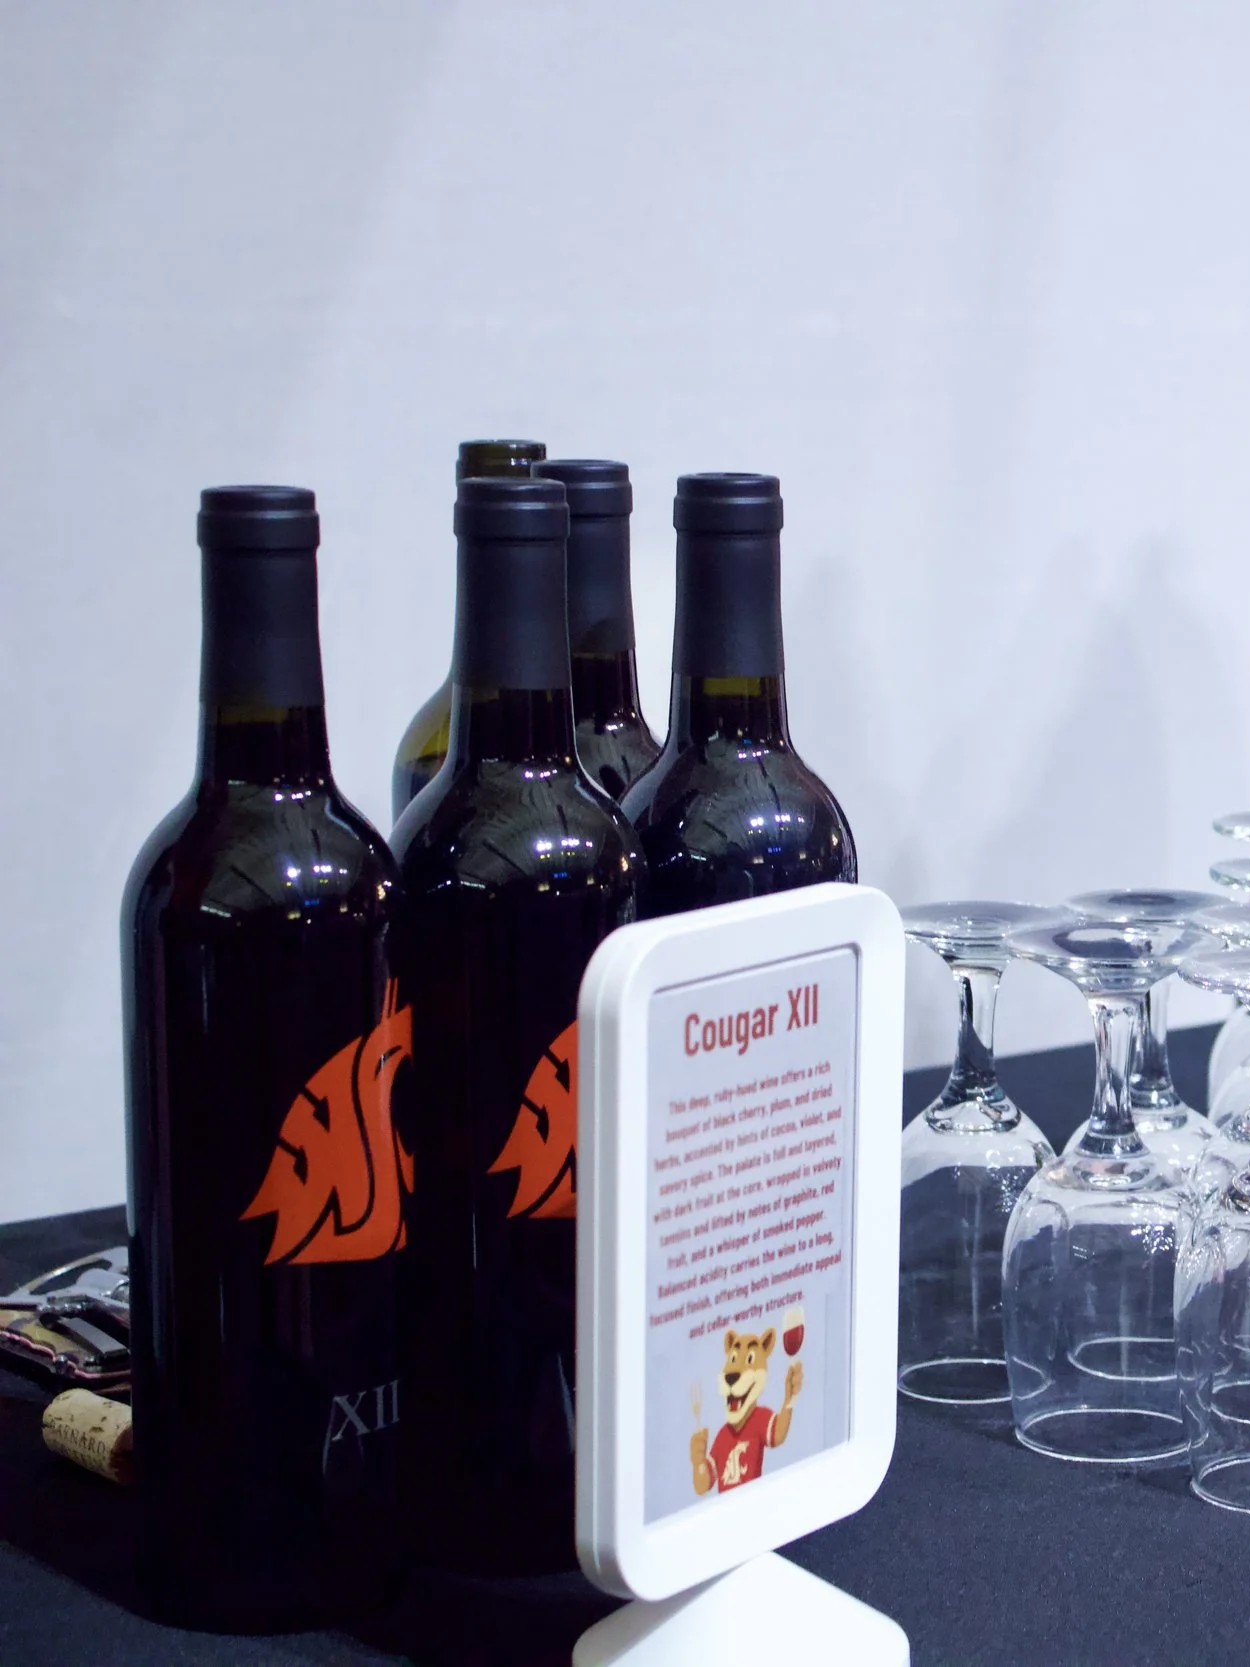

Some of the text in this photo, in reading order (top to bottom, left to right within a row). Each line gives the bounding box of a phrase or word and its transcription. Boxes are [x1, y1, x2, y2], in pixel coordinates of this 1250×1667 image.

[684, 983, 820, 1056] Cougar XII
[670, 1102, 686, 1114] This
[714, 1080, 757, 1102] ruby-hued
[760, 1077, 778, 1090] wine
[781, 1070, 805, 1085] offers
[808, 1068, 812, 1078] a
[815, 1062, 830, 1076] rich
[703, 1118, 711, 1132] of
[714, 1112, 736, 1128] black
[795, 1091, 809, 1106] and
[812, 1085, 832, 1101] dried
[725, 1139, 734, 1152] by
[760, 1126, 768, 1140] of
[827, 1106, 841, 1121] and
[718, 1164, 733, 1177] The
[736, 1156, 761, 1175] palate
[764, 1153, 770, 1164] is
[773, 1146, 786, 1161] full
[789, 1141, 802, 1156] and
[654, 1208, 673, 1224] with
[674, 1201, 692, 1217] dark
[696, 1194, 713, 1210] fruit
[716, 1191, 724, 1204] at
[728, 1187, 740, 1200] the
[767, 1166, 801, 1188] wrapped
[803, 1164, 810, 1177] in
[814, 1157, 841, 1174] velvety
[694, 1220, 709, 1236] and
[736, 1210, 745, 1224] by
[748, 1203, 771, 1218] notes
[774, 1196, 781, 1211] of
[822, 1180, 834, 1195] red
[691, 1246, 706, 1263] and
[710, 1246, 714, 1257] a
[717, 1235, 750, 1254] whisper
[752, 1228, 760, 1243] of
[763, 1217, 794, 1239] smoked
[650, 1304, 684, 1328] focused
[715, 1285, 748, 1304] offering
[751, 1276, 769, 1292] both
[816, 1249, 842, 1271] appeal
[658, 1275, 697, 1299] Balanced
[700, 1266, 728, 1285] acidity
[731, 1256, 760, 1274] carries
[763, 1250, 775, 1263] the
[778, 1244, 796, 1258] wine
[798, 1240, 806, 1251] to
[809, 1238, 813, 1248] a
[690, 1322, 705, 1339] and
[707, 1304, 763, 1333] cellar-worthy
[331, 1379, 400, 1442] XII
